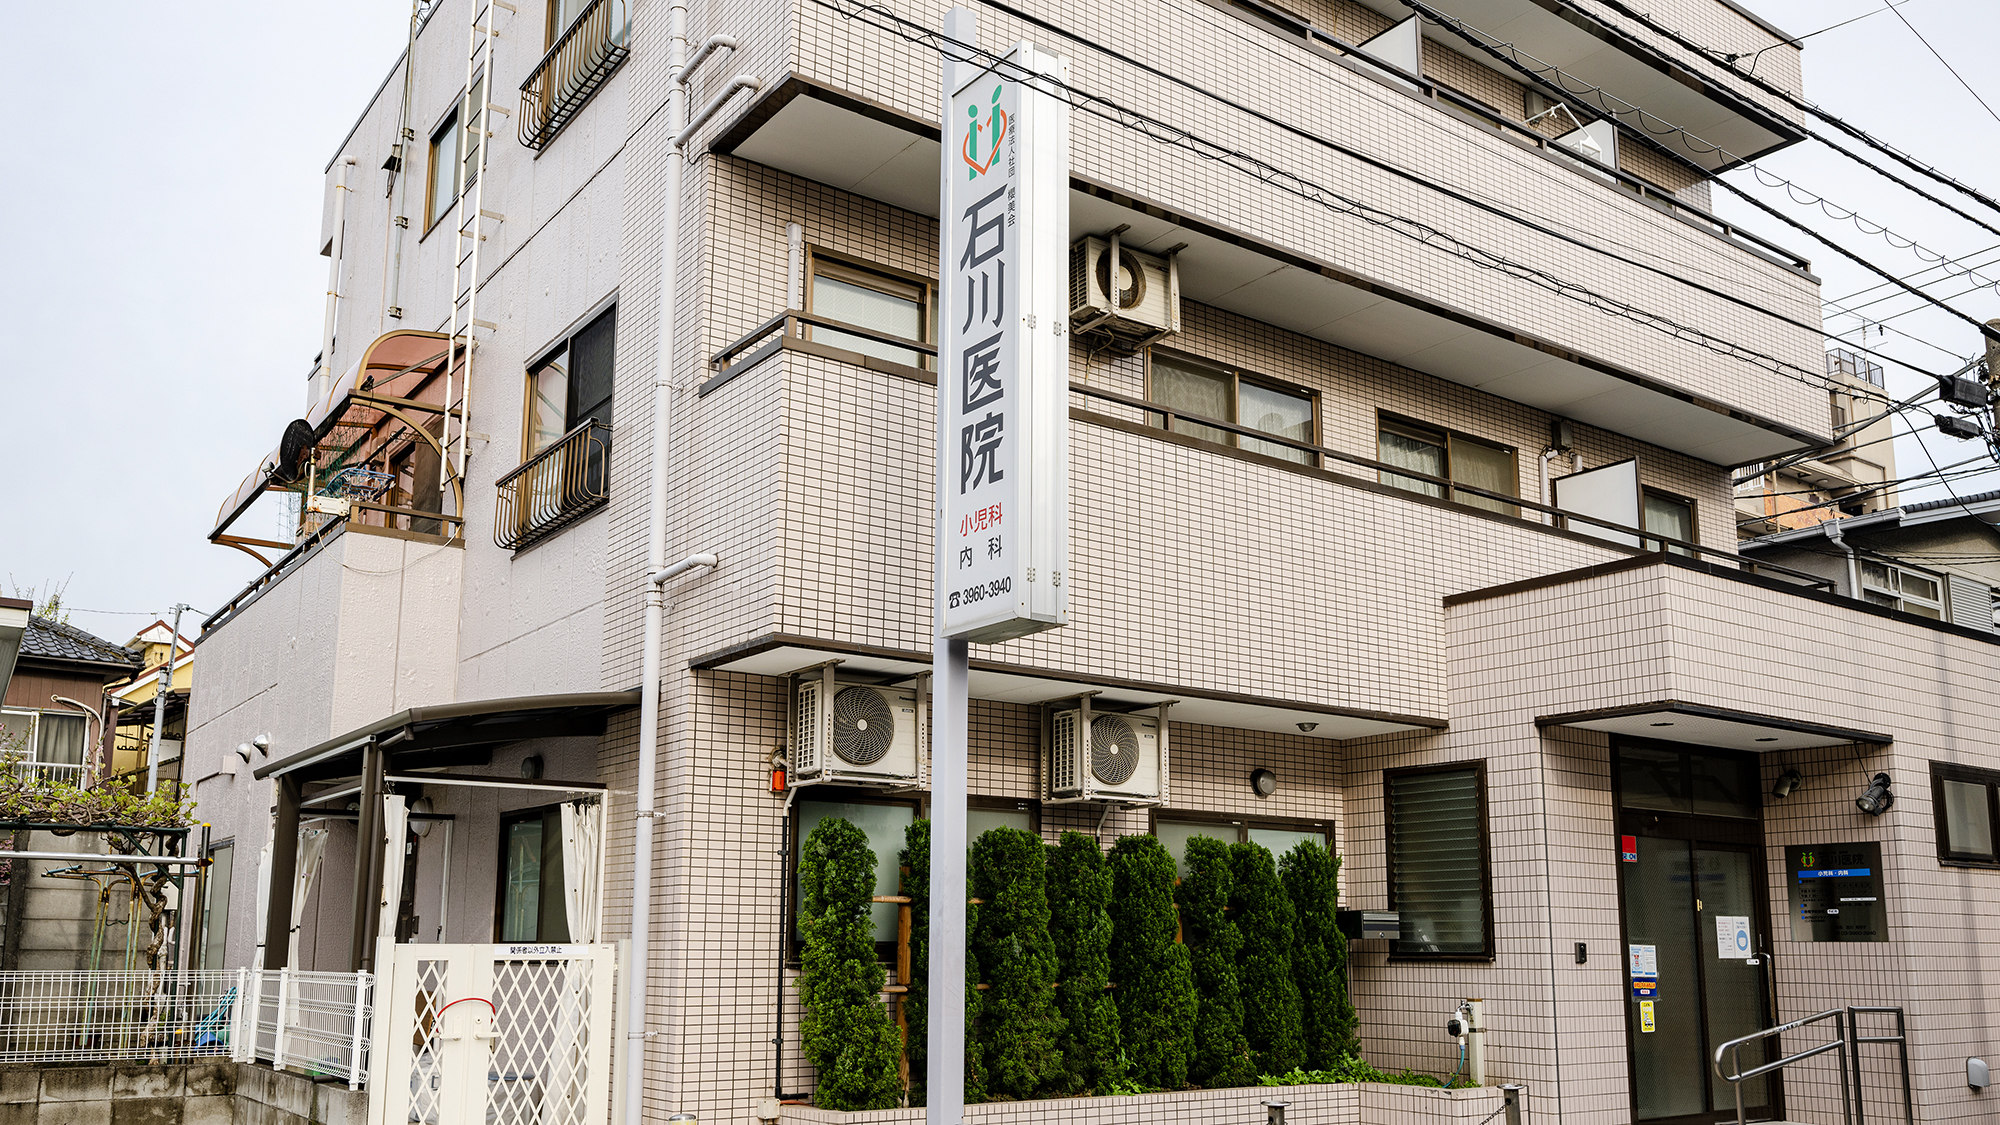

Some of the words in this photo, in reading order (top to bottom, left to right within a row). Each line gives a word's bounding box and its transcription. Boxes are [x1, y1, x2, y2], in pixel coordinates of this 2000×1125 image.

[960, 183, 1008, 495] 石川医院
[960, 502, 1003, 537] 小児科
[963, 576, 1012, 605] 3960-3940
[1818, 854, 1864, 866] 石川医院
[510, 946, 562, 955] 関係者以外立入禁止
